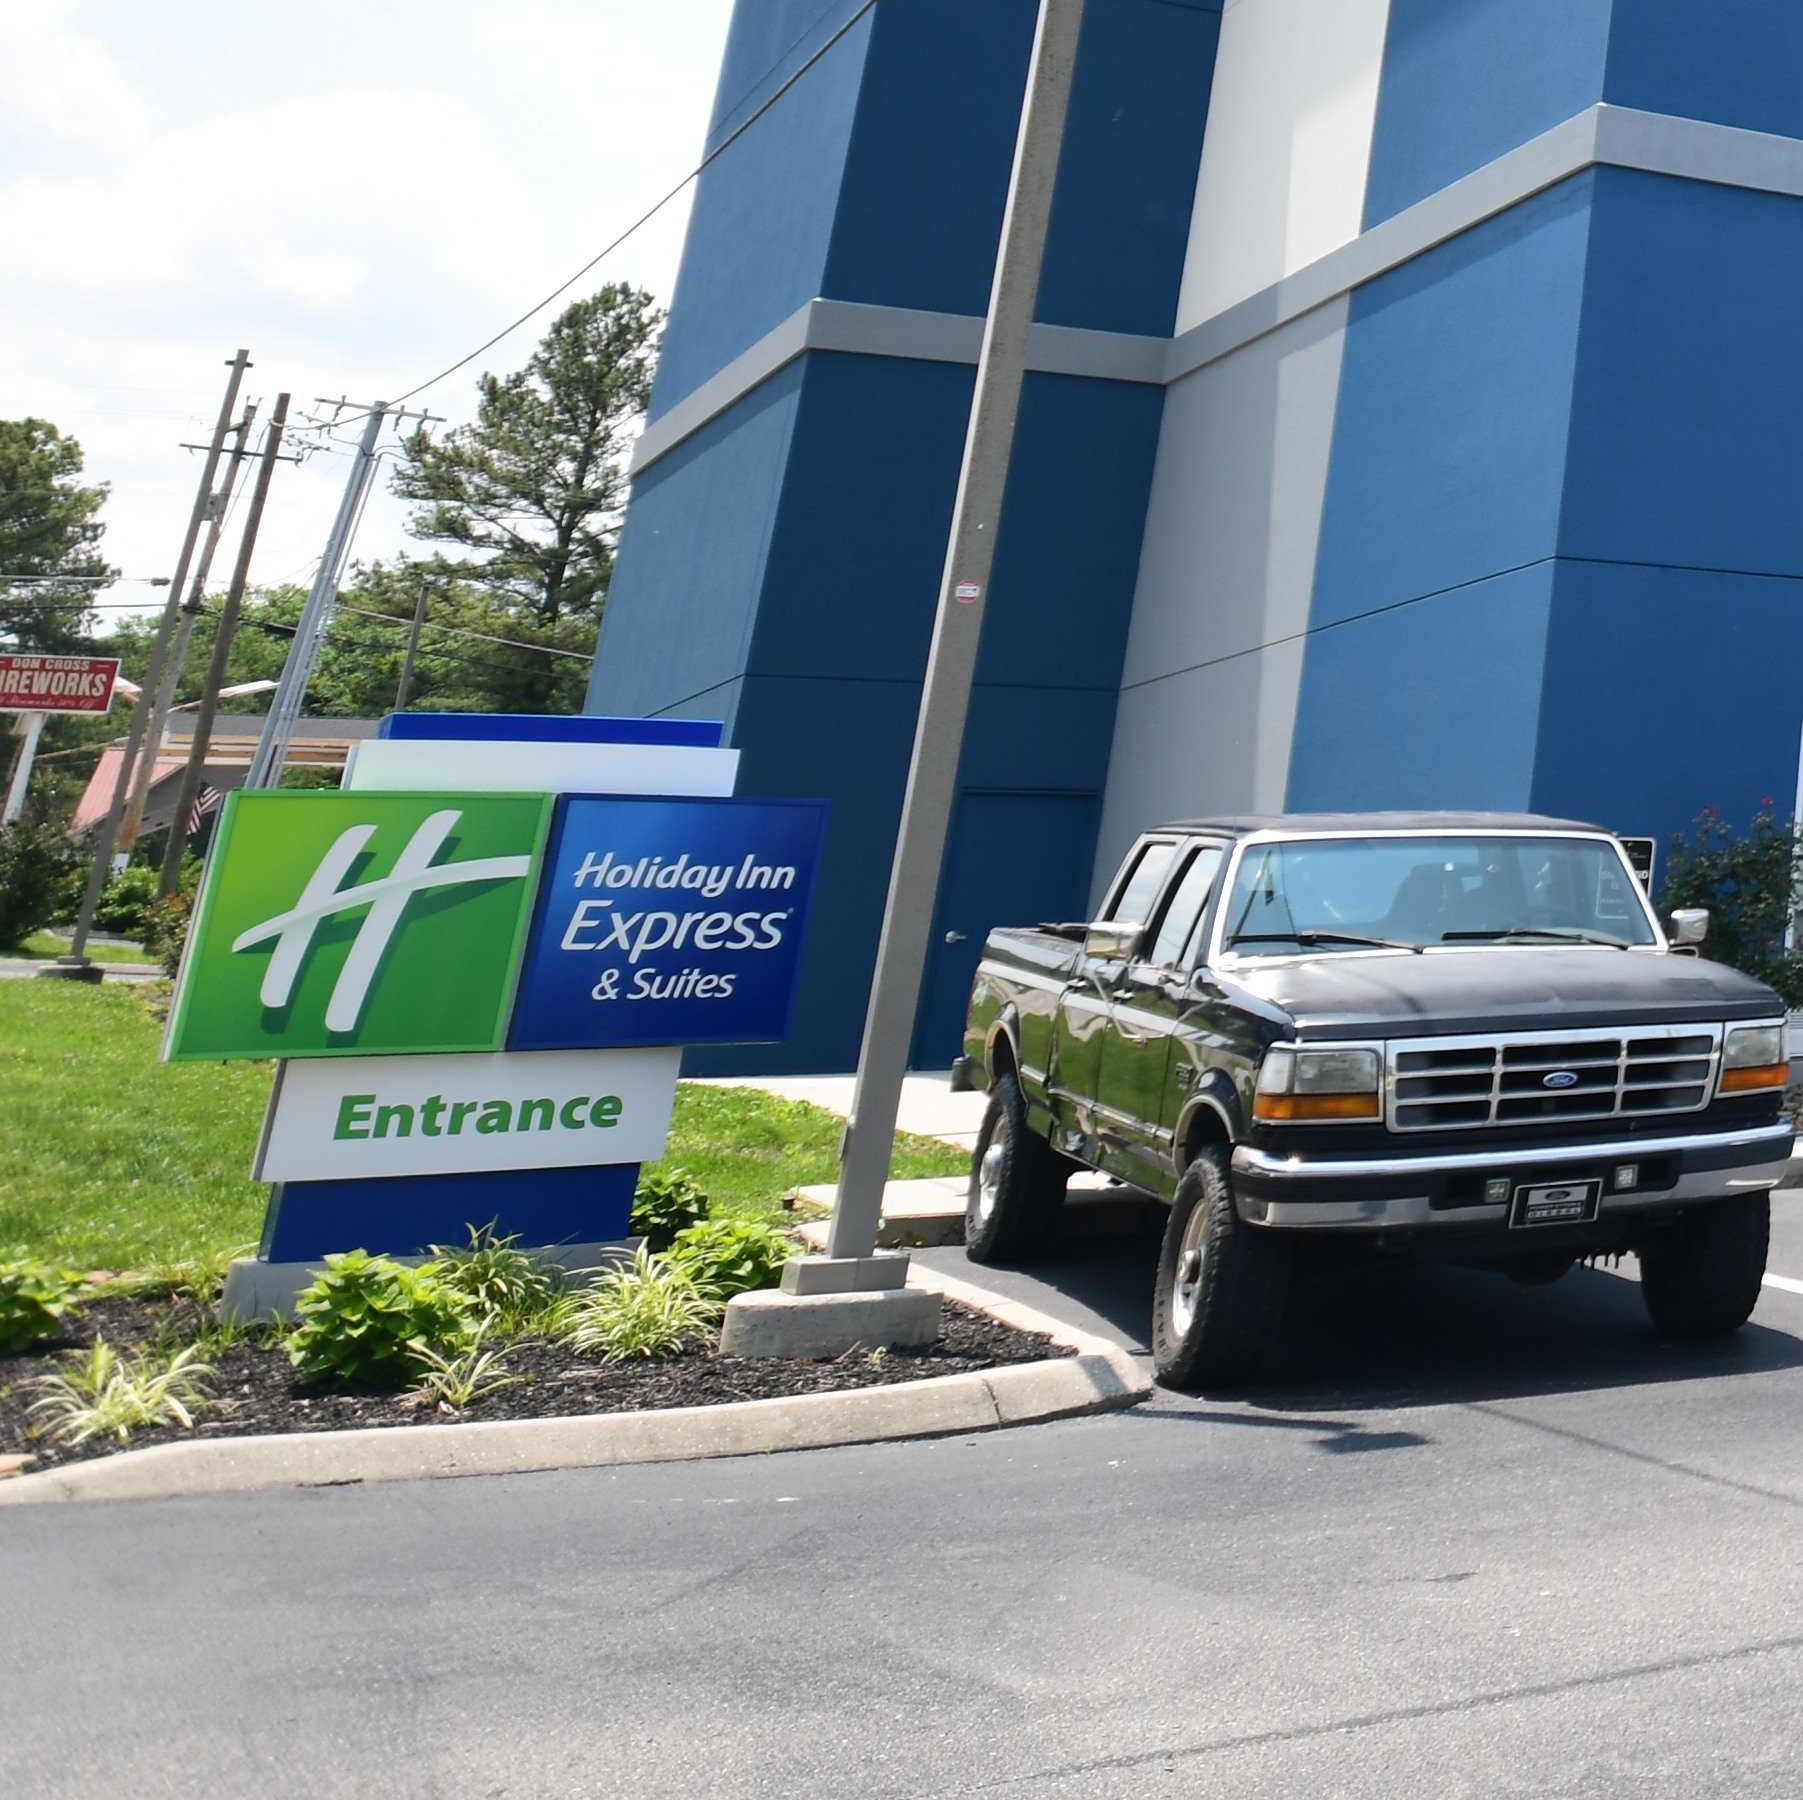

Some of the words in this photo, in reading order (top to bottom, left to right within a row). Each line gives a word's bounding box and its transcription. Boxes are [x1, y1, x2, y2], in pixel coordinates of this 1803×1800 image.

[12, 658, 41, 669] DON
[45, 659, 90, 671] CROSS
[573, 852, 734, 898] Holiday
[735, 854, 796, 889] Inn
[560, 900, 788, 964] Express
[591, 968, 621, 1001] &
[626, 968, 737, 999] Suites
[333, 1094, 623, 1140] Entrance
